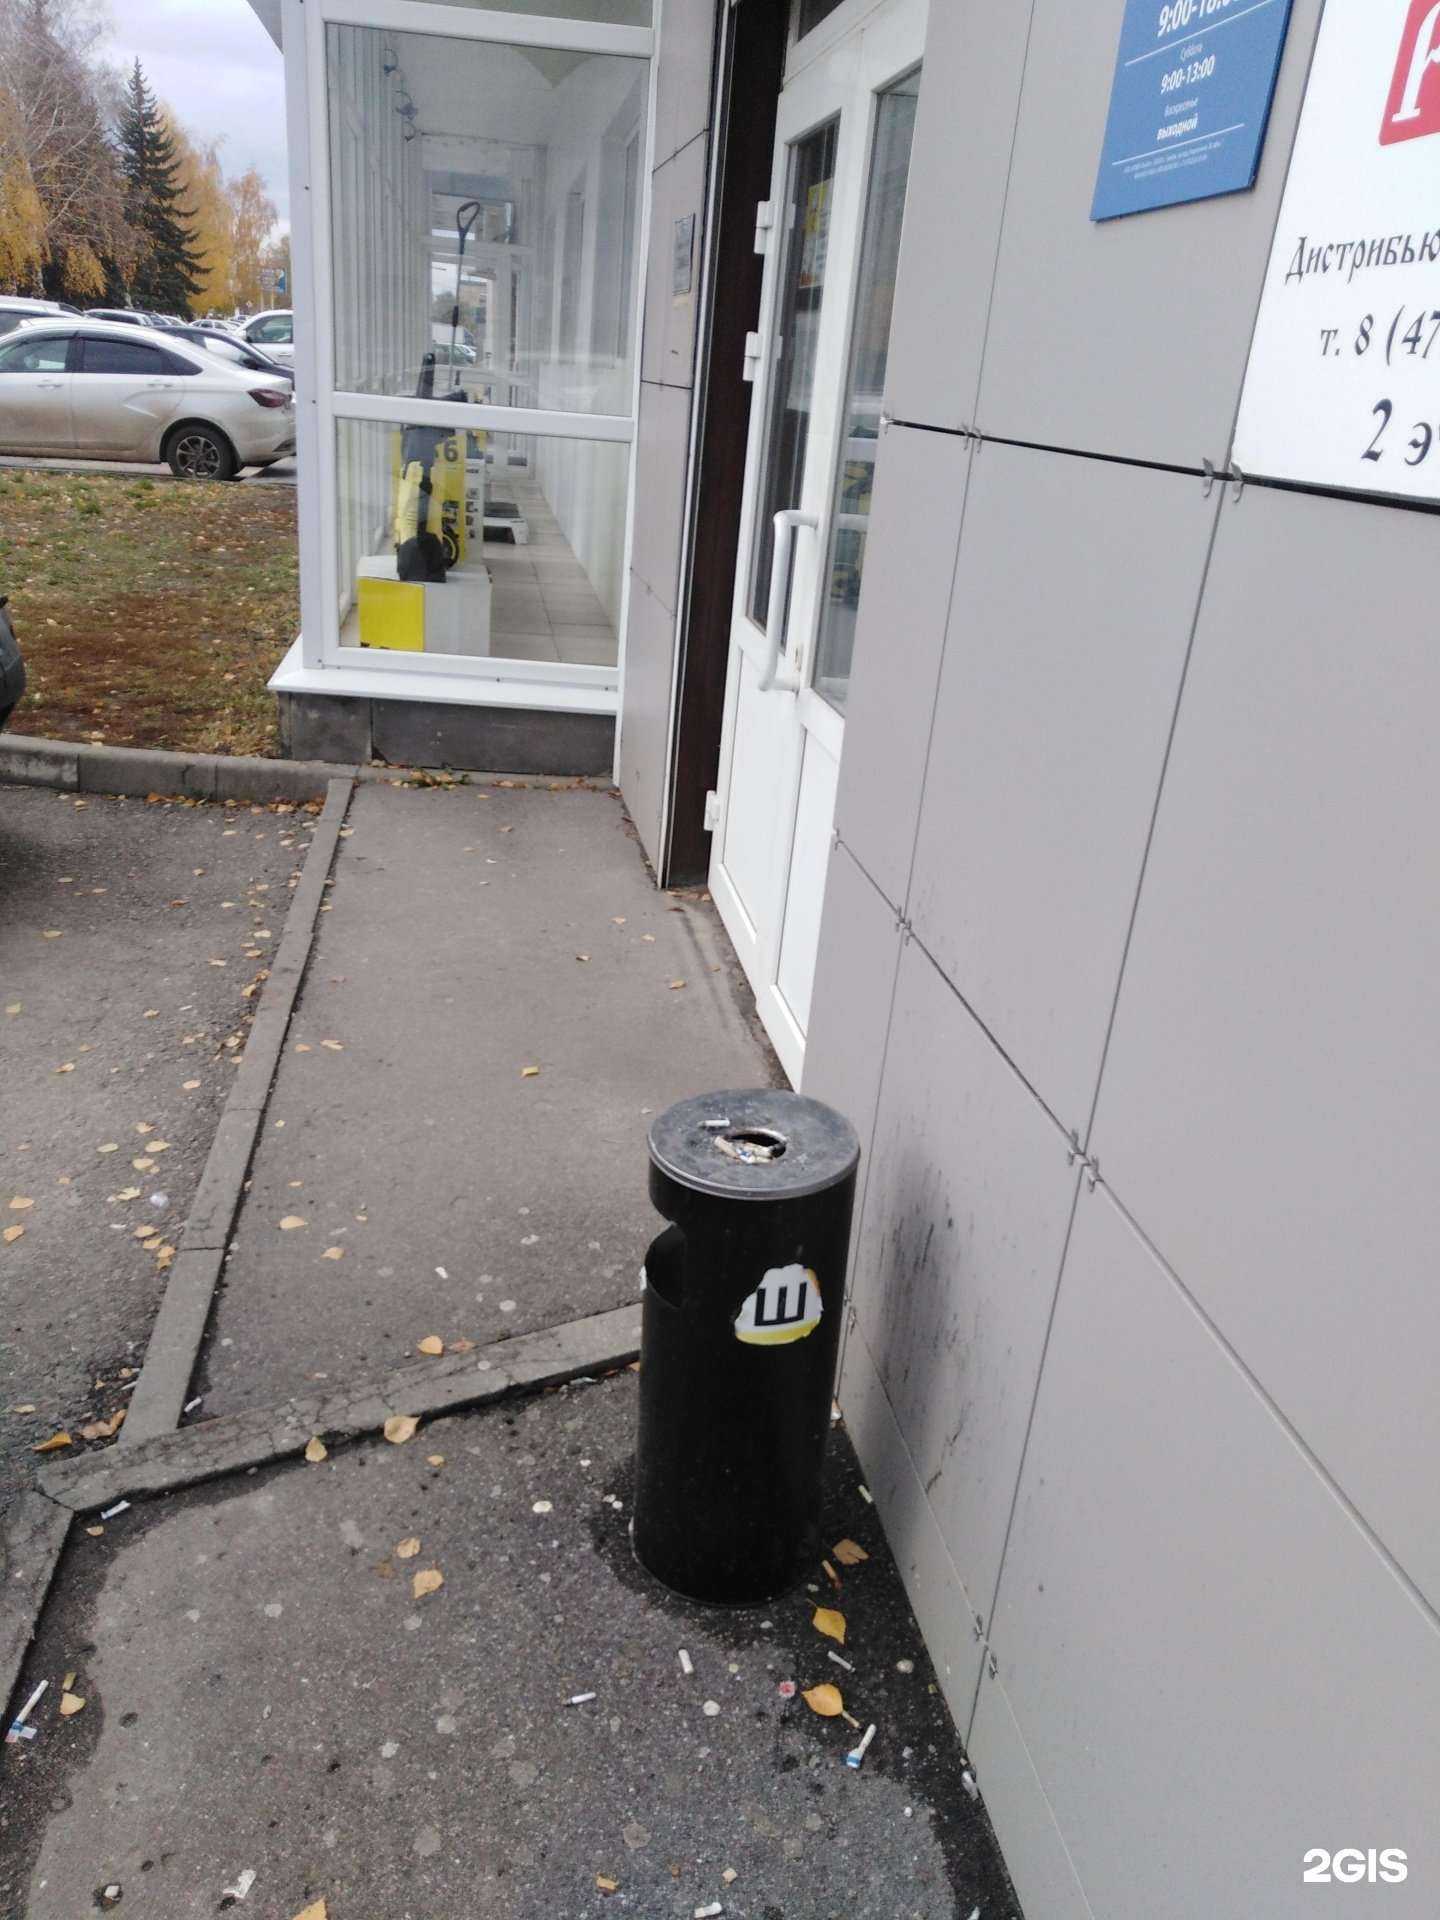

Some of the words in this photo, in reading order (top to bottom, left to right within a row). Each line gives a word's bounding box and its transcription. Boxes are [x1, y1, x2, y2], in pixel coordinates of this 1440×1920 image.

[1160, 54, 1216, 95] 9:00-13:00
[1321, 328, 1340, 356] т.
[1355, 313, 1374, 356] 8
[1386, 304, 1440, 366] (47
[1361, 398, 1393, 462] 2
[1405, 421, 1440, 466] э
